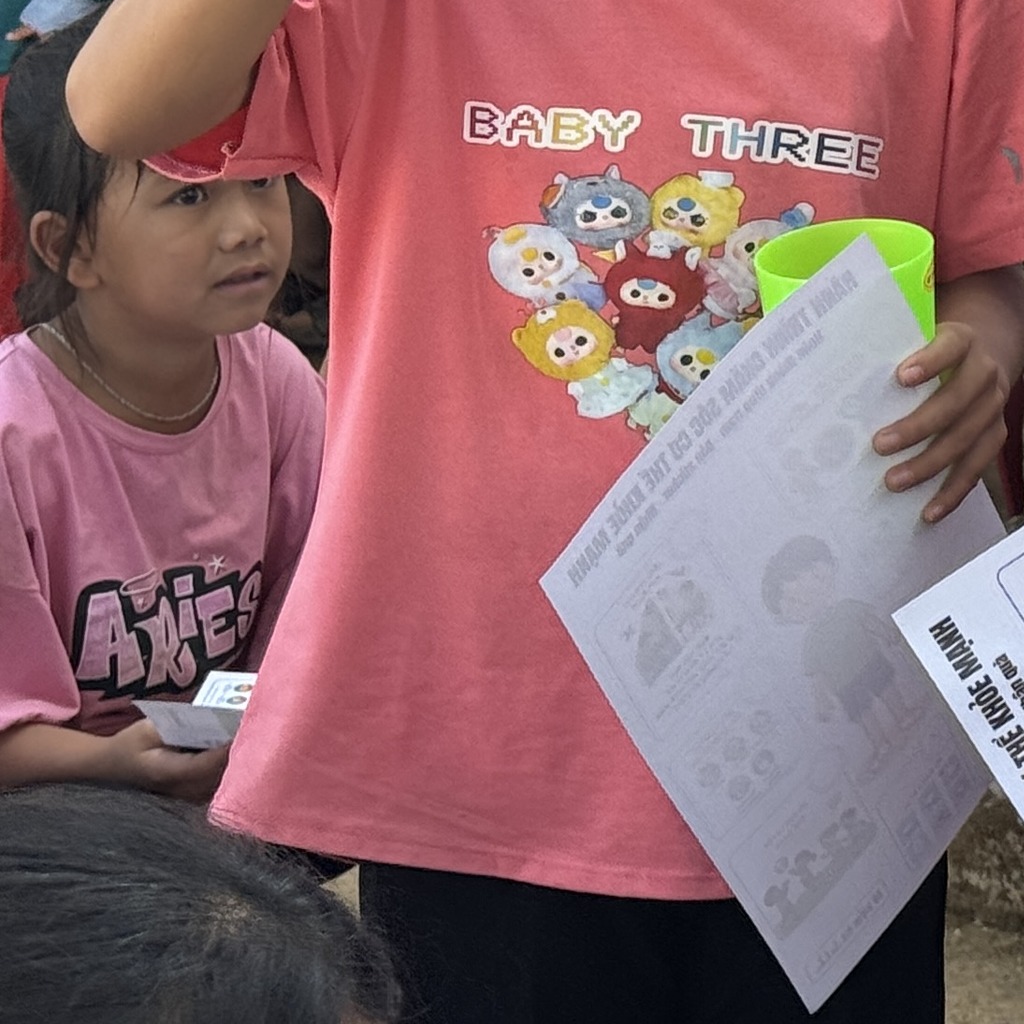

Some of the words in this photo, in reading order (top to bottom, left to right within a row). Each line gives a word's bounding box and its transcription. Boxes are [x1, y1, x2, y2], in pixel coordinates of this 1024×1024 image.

[462, 99, 641, 153] BABY
[680, 113, 885, 179] THREE
[929, 616, 982, 680] MẠNH
[993, 654, 1017, 680] quà
[968, 674, 1014, 730] KHỎE
